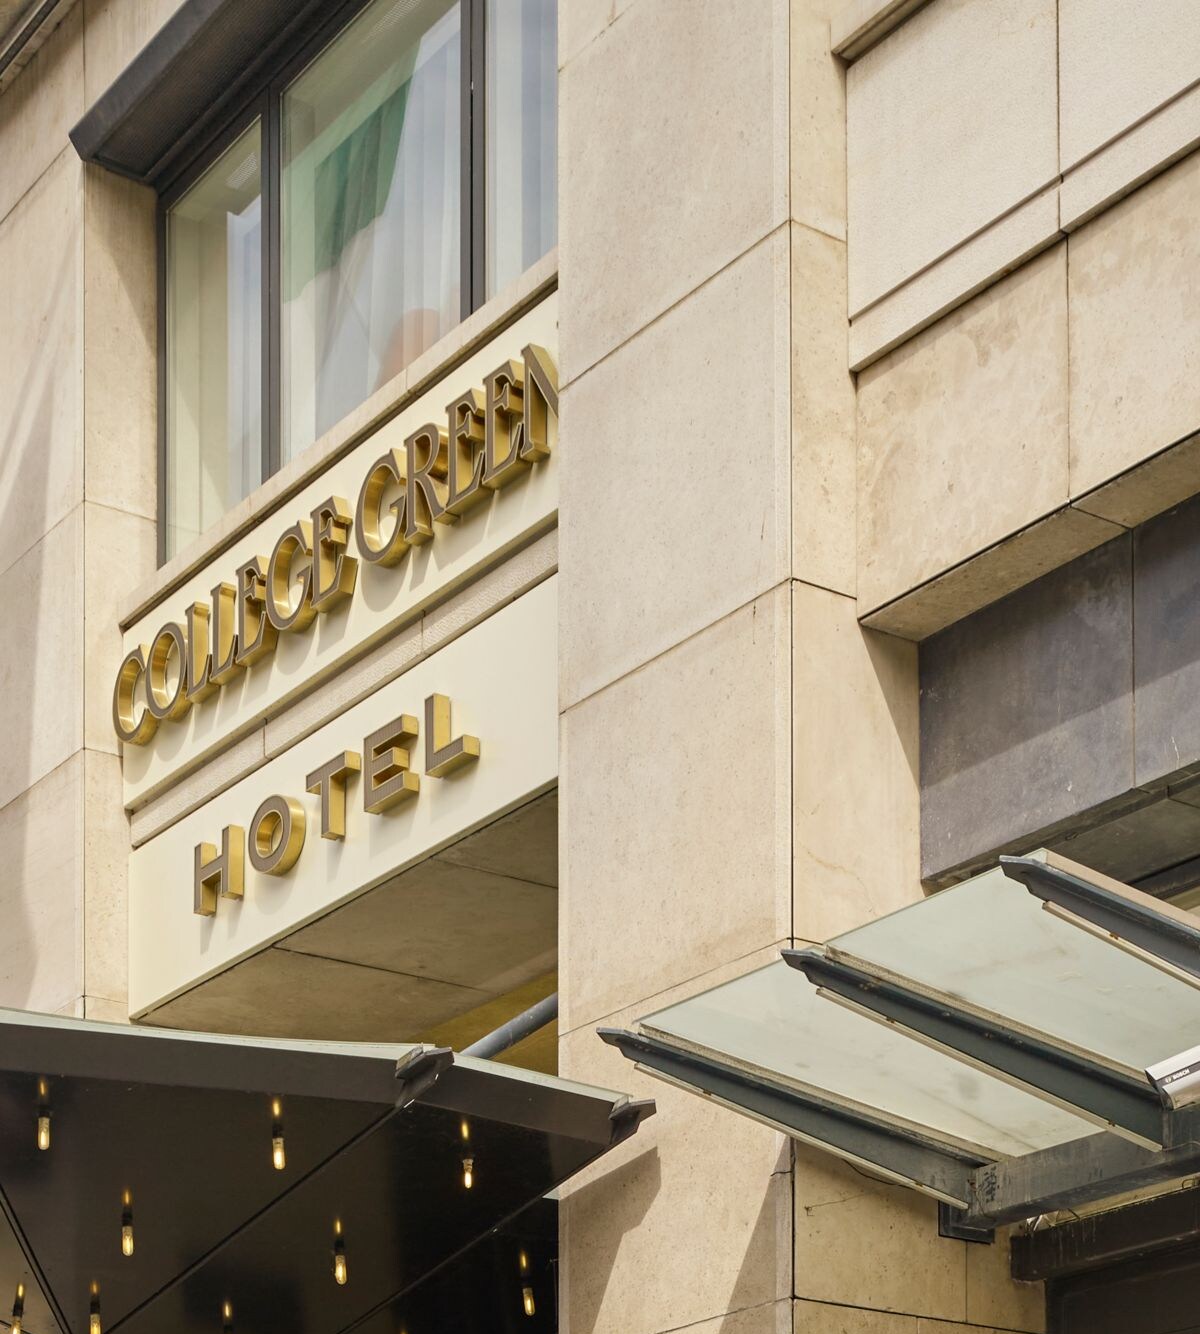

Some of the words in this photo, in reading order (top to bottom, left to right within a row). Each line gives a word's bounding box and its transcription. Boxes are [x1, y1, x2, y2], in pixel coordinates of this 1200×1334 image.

[113, 496, 358, 746] COLLEGE
[355, 344, 558, 567] GREEN
[194, 694, 480, 917] HOTEL
